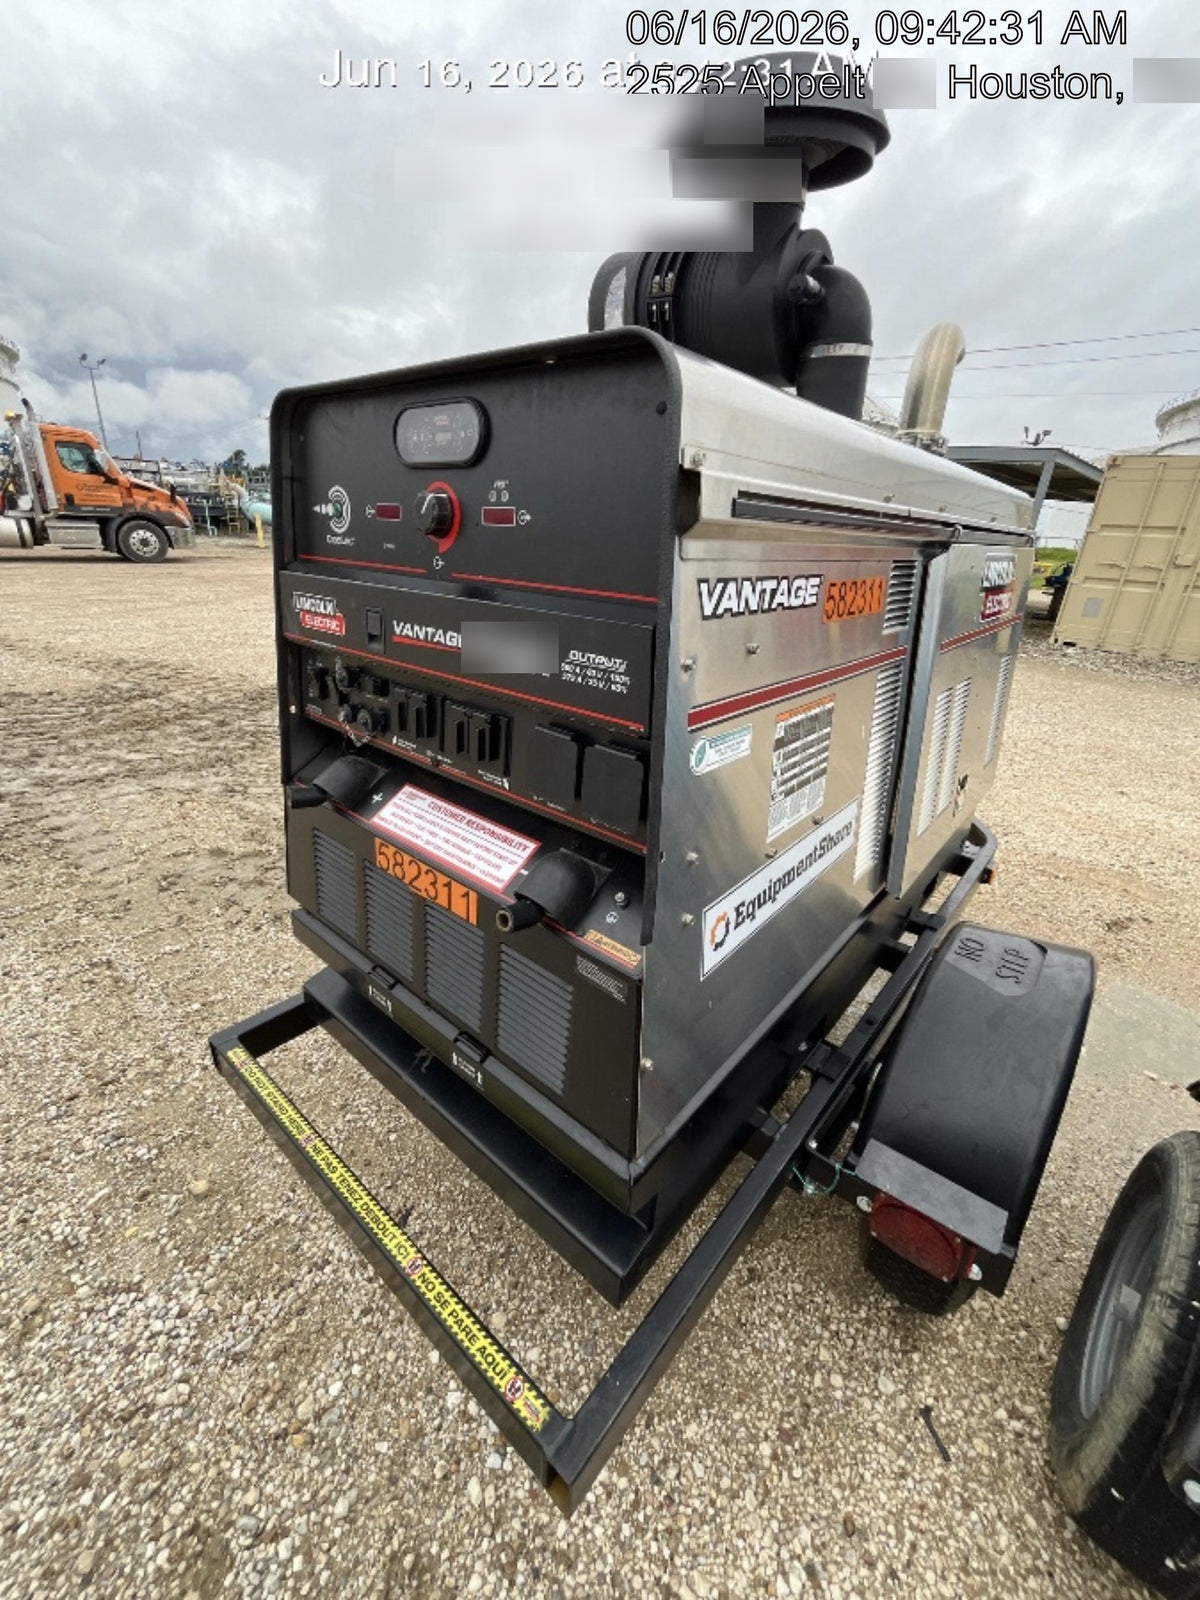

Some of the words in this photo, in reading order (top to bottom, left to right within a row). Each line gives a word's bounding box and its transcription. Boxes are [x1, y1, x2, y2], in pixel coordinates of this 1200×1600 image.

[392, 620, 462, 648] VANTAG
[699, 575, 823, 619] VANTAGE
[825, 580, 884, 619] 582311
[378, 841, 471, 923] 582311
[733, 821, 853, 930] EquipmentShare
[336, 1173, 363, 1204] TENEZ
[360, 1201, 398, 1242] DEBOUT
[394, 1242, 410, 1260] ICI
[417, 1272, 437, 1293] NO
[433, 1291, 449, 1311] SE
[448, 1309, 481, 1347] PARE
